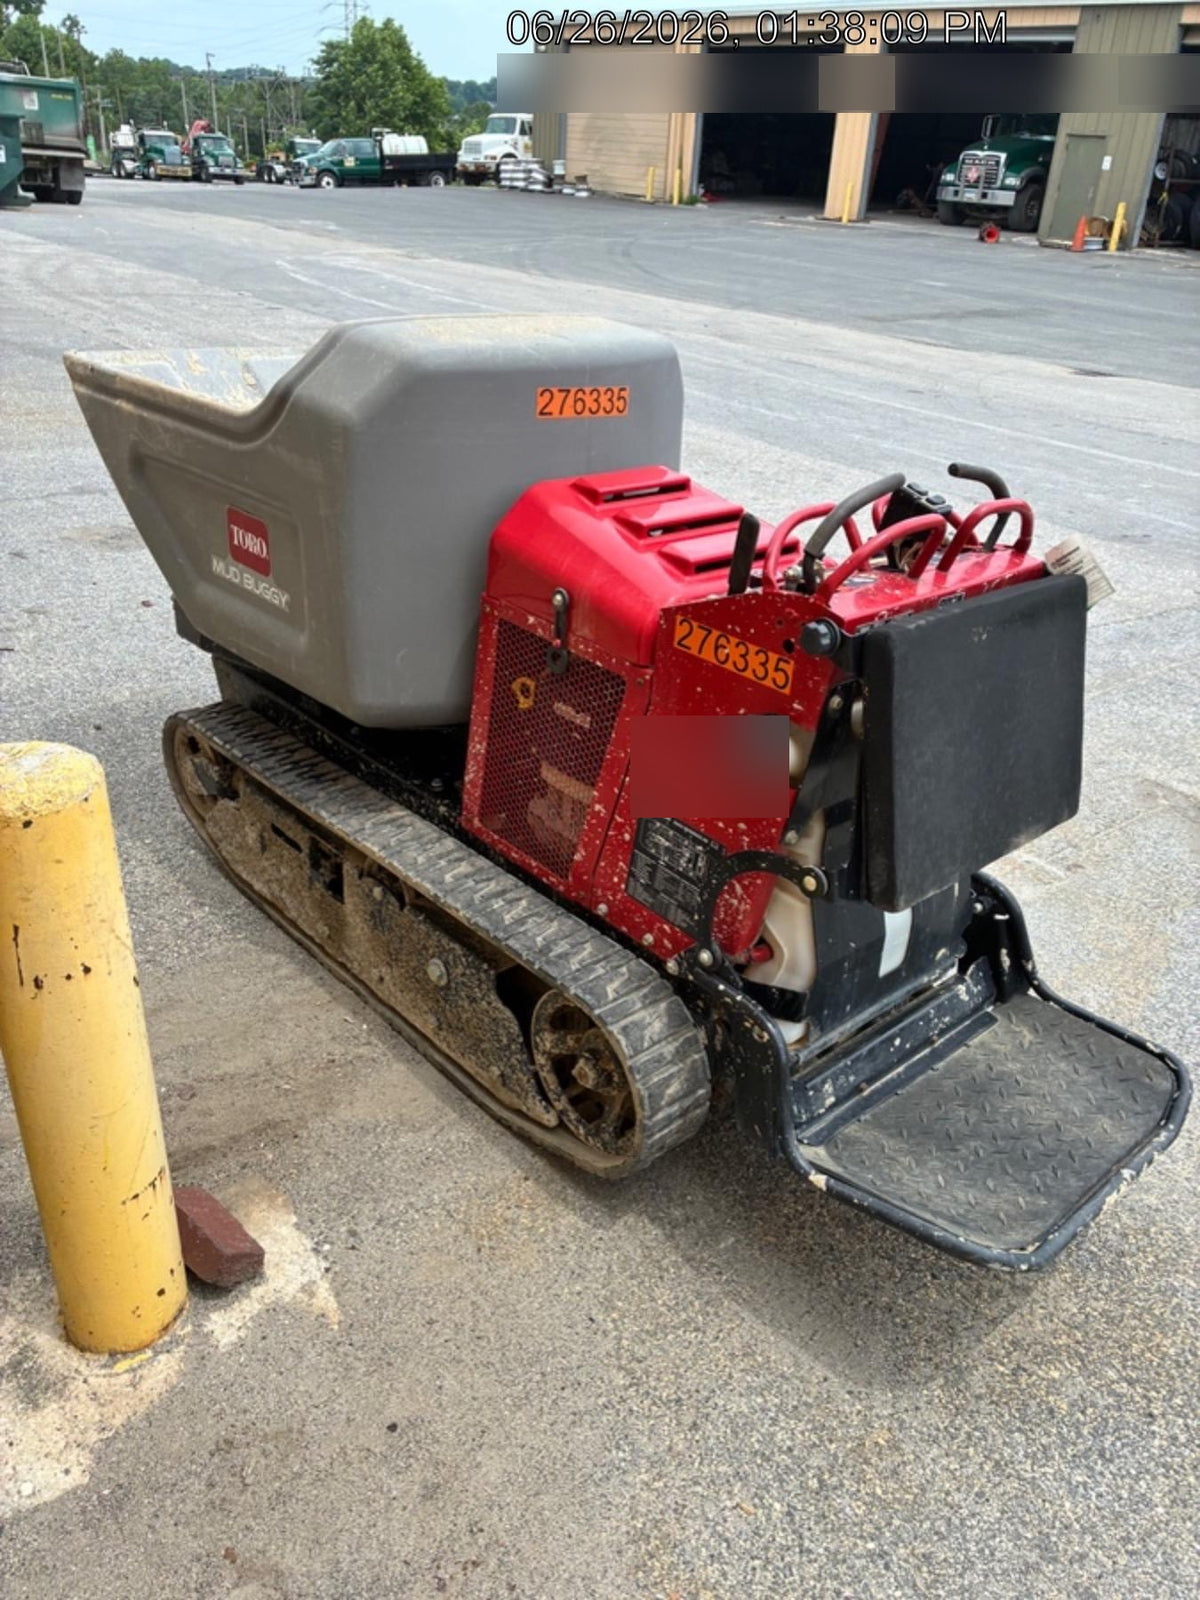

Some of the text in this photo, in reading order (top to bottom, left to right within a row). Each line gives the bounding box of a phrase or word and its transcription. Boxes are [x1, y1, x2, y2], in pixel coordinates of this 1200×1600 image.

[538, 387, 627, 416] 276335
[230, 524, 268, 558] TORO
[211, 554, 290, 612] MUD BUGGY
[677, 618, 790, 691] 276335
